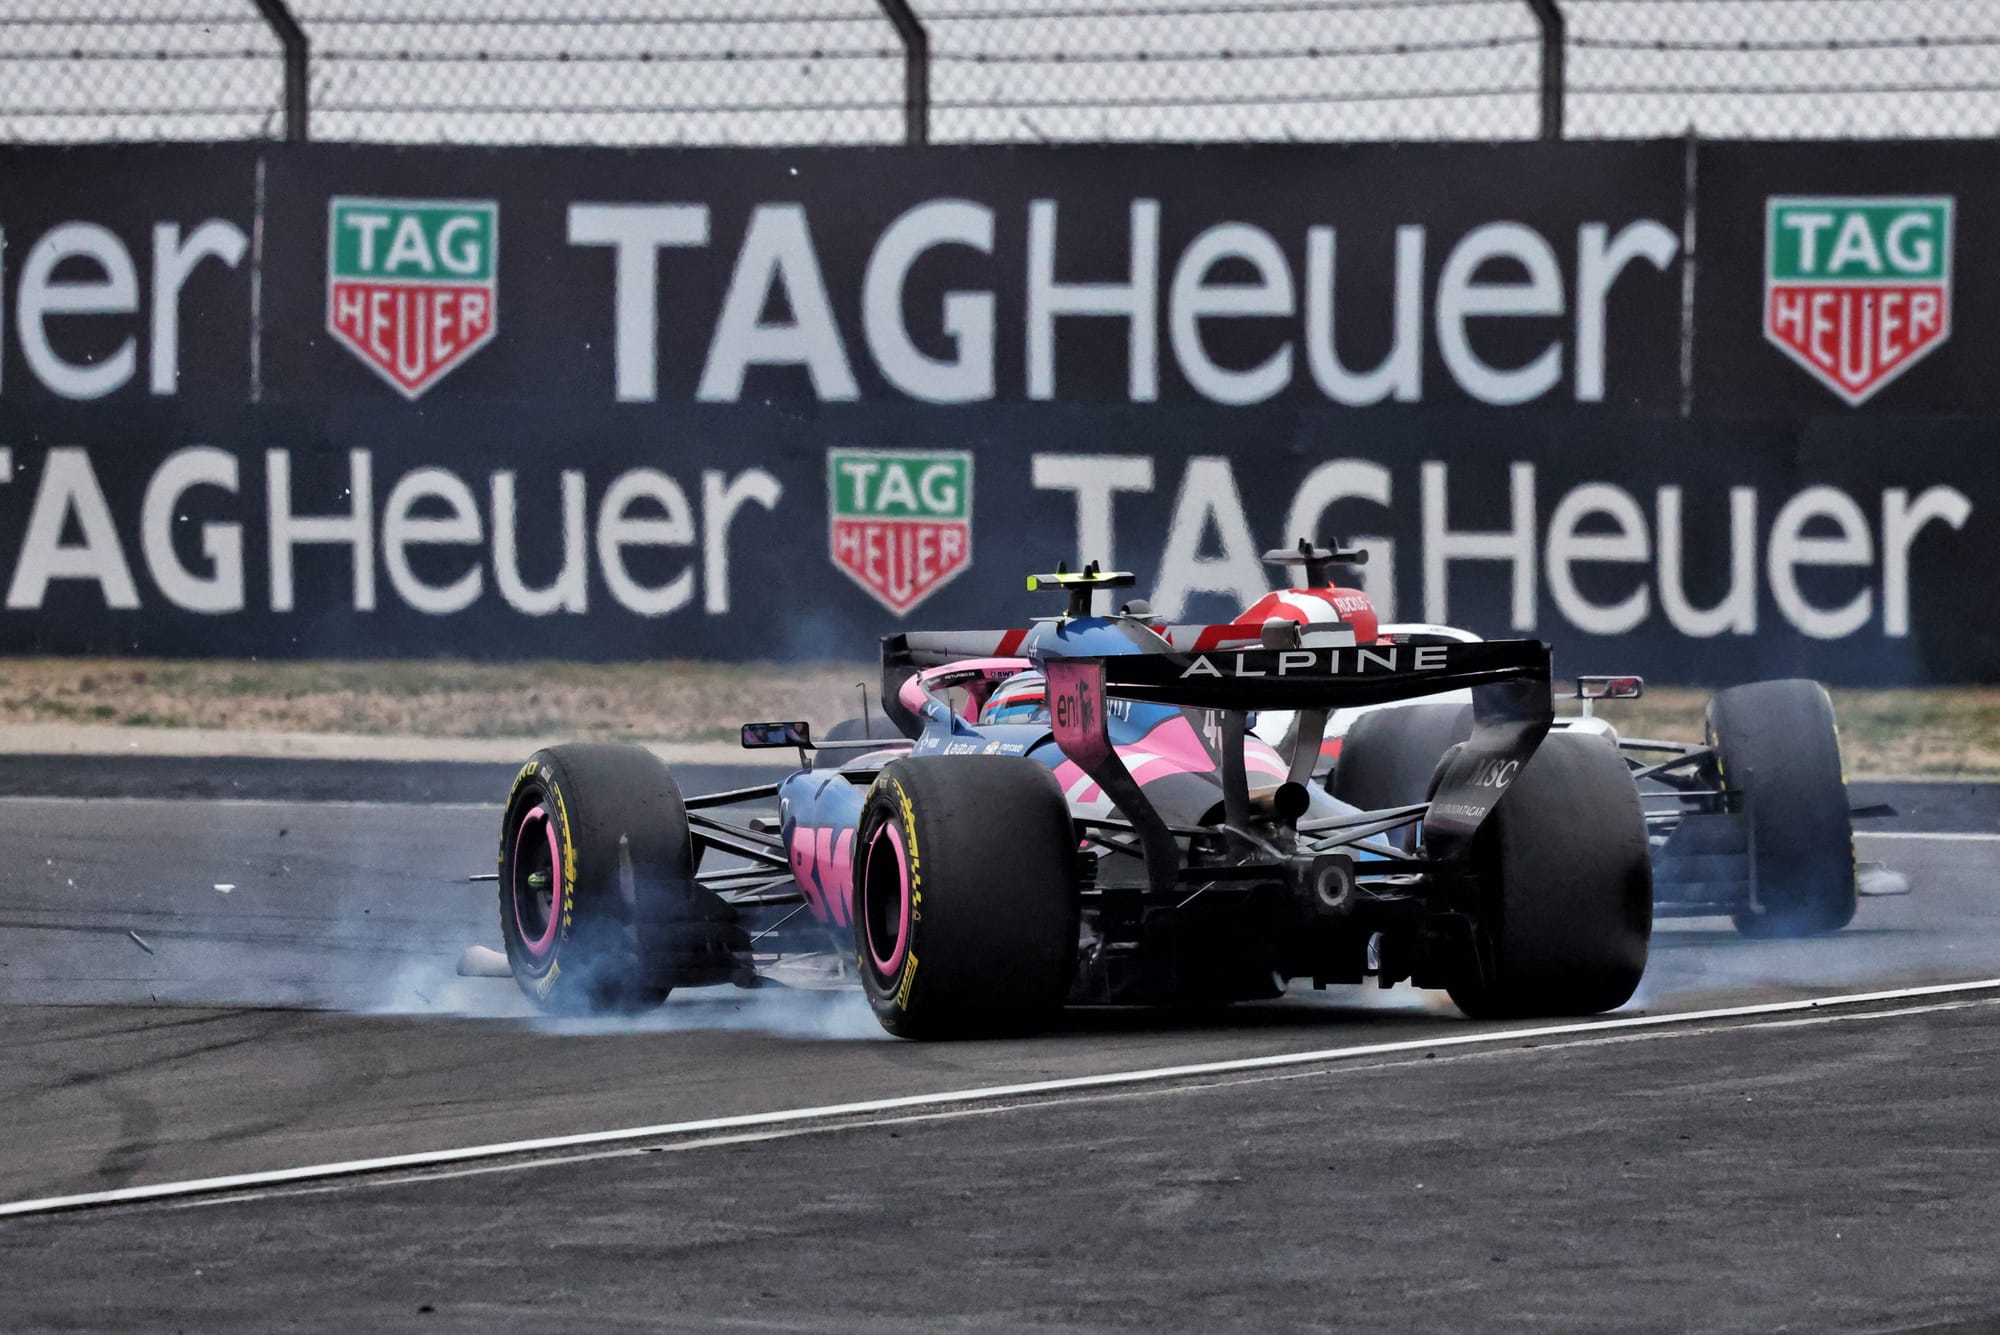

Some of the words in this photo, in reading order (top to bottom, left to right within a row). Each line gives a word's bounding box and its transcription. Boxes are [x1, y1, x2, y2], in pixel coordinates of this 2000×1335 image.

[345, 213, 481, 274] TAG
[1784, 212, 1934, 274] TAG
[0, 220, 248, 399] er
[336, 288, 487, 380] HEUER
[1774, 288, 1943, 385] HEUER
[839, 462, 958, 513] TAG
[0, 446, 783, 616] AGHeuer
[836, 523, 963, 600] HEUER
[1179, 645, 1449, 679] ALPINE
